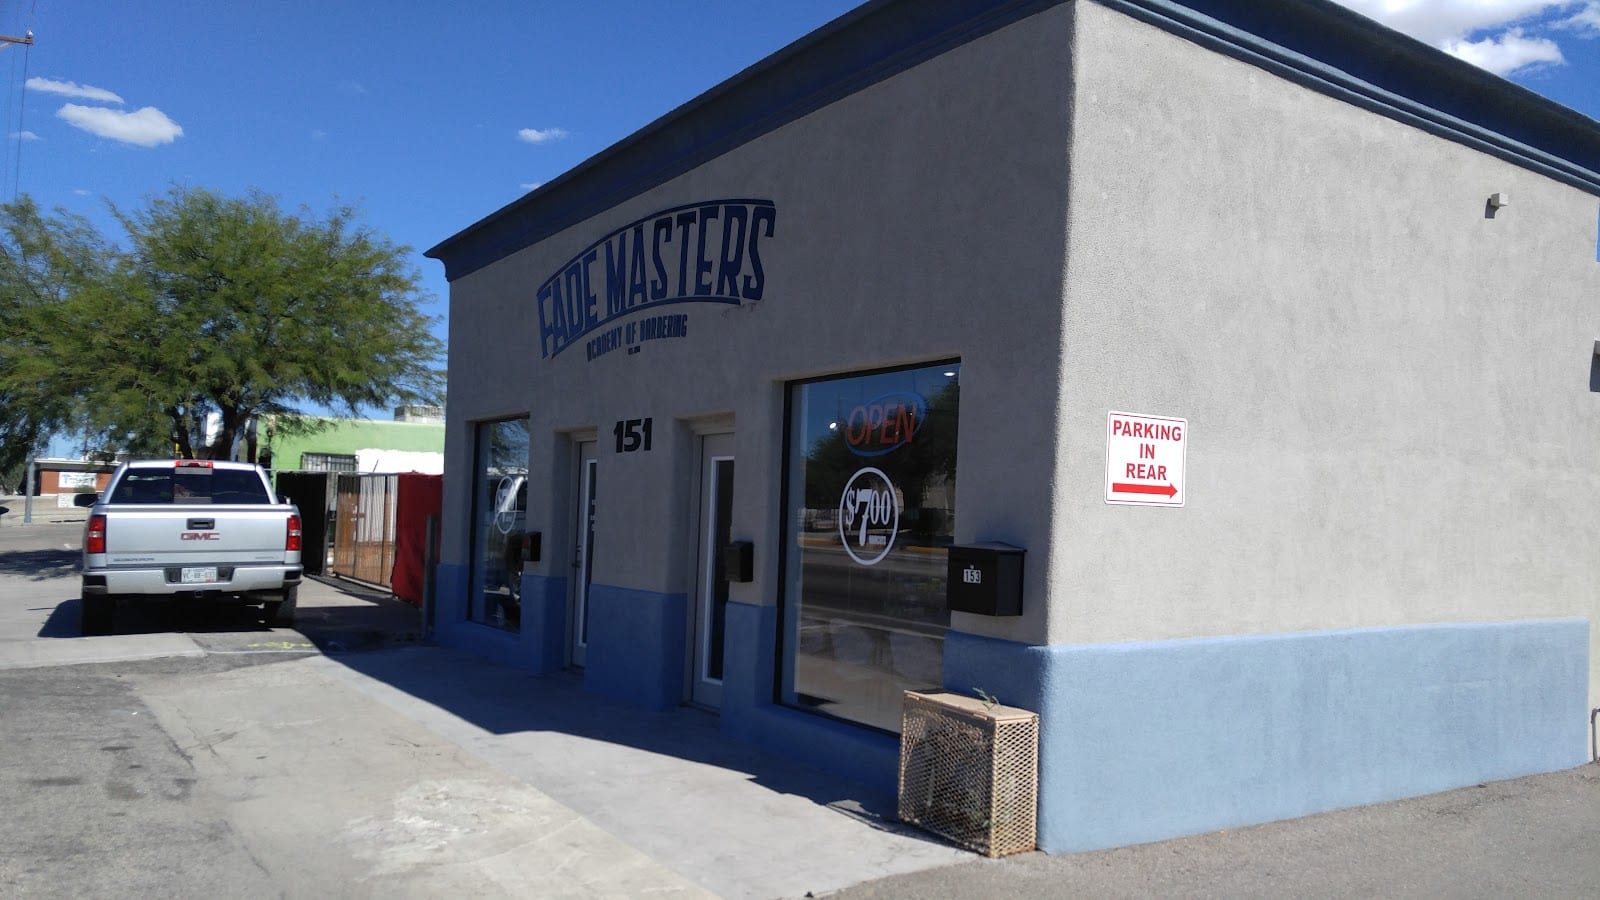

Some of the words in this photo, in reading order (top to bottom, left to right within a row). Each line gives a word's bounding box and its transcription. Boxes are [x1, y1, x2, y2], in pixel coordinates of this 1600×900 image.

[536, 249, 599, 360] FADE
[605, 205, 776, 315] MASTERS
[625, 321, 641, 345] OF
[640, 314, 688, 342] BARBERING
[847, 402, 917, 446] OPEN
[1113, 420, 1181, 441] PARKING
[613, 417, 653, 454] 151
[1139, 443, 1155, 460] IN
[1126, 463, 1167, 480] REAR
[180, 532, 221, 541] GMC
[965, 570, 981, 582] 153
